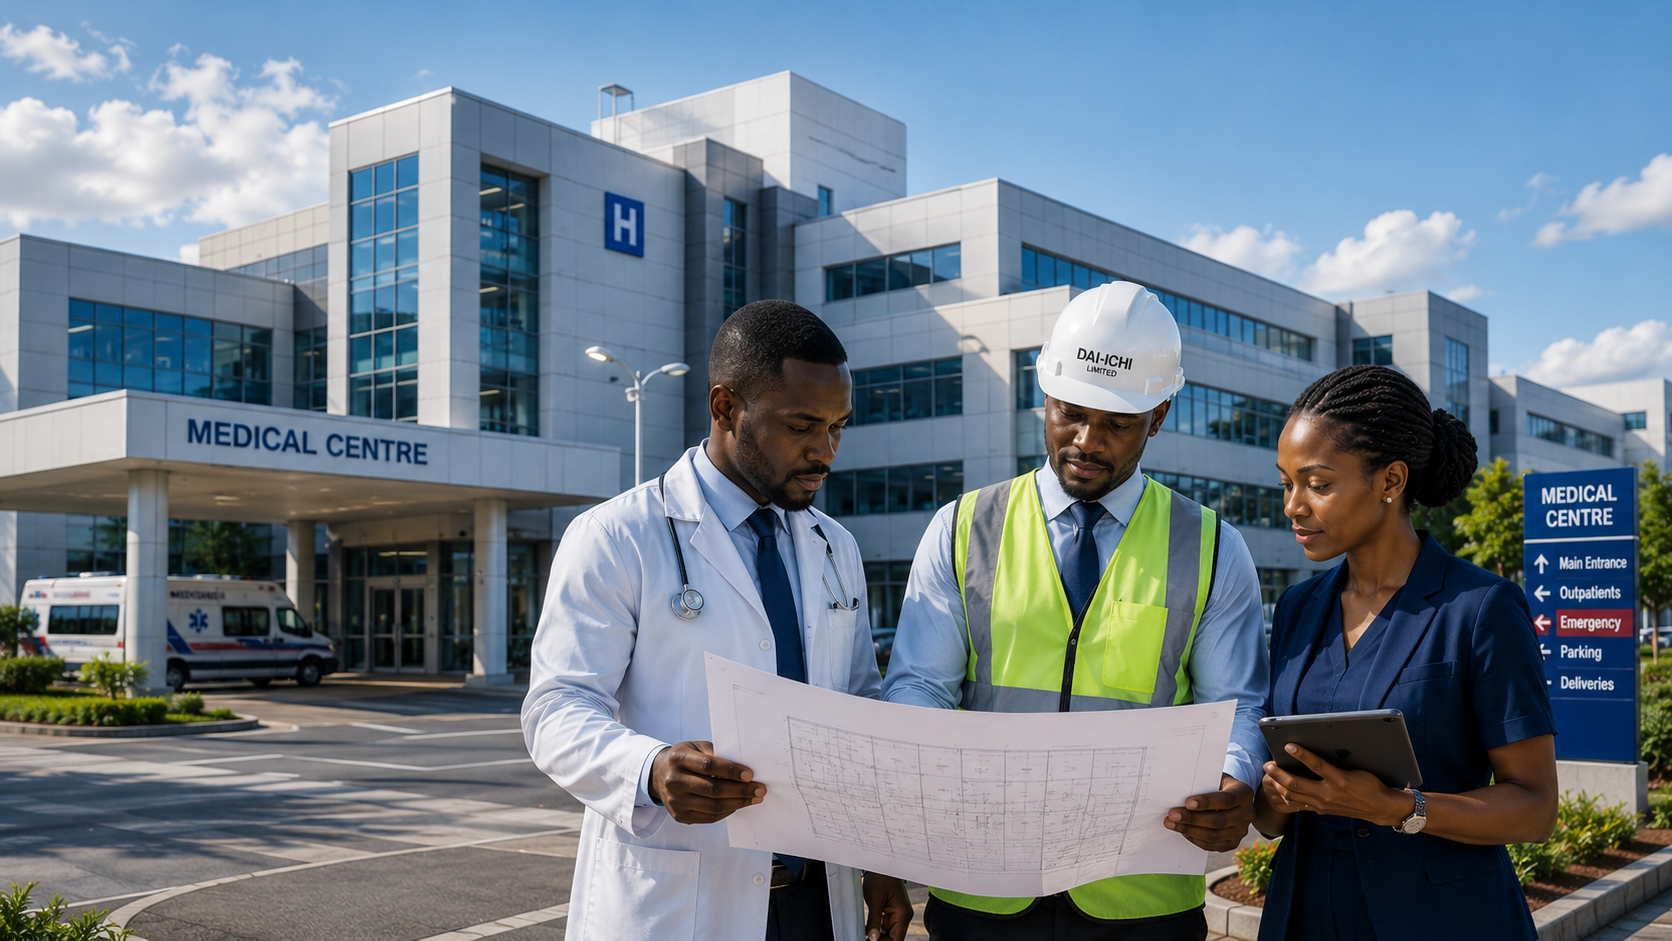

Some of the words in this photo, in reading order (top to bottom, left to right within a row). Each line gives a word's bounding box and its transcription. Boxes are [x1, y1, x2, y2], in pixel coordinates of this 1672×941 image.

[614, 203, 637, 246] H
[1076, 347, 1133, 370] DAI-ICHI
[1086, 364, 1117, 377] LIMITED
[187, 418, 317, 455] MEDICAL
[326, 433, 428, 465] CENTRE
[1541, 484, 1617, 504] MEDICAL
[1545, 508, 1613, 527] CENTRE
[1559, 556, 1583, 570] Main
[1585, 556, 1627, 570] Entrance
[1559, 586, 1621, 602] Outpatients
[1560, 615, 1621, 632] Emergency
[1560, 645, 1602, 662] Parking
[1560, 676, 1614, 691] Deliveries
